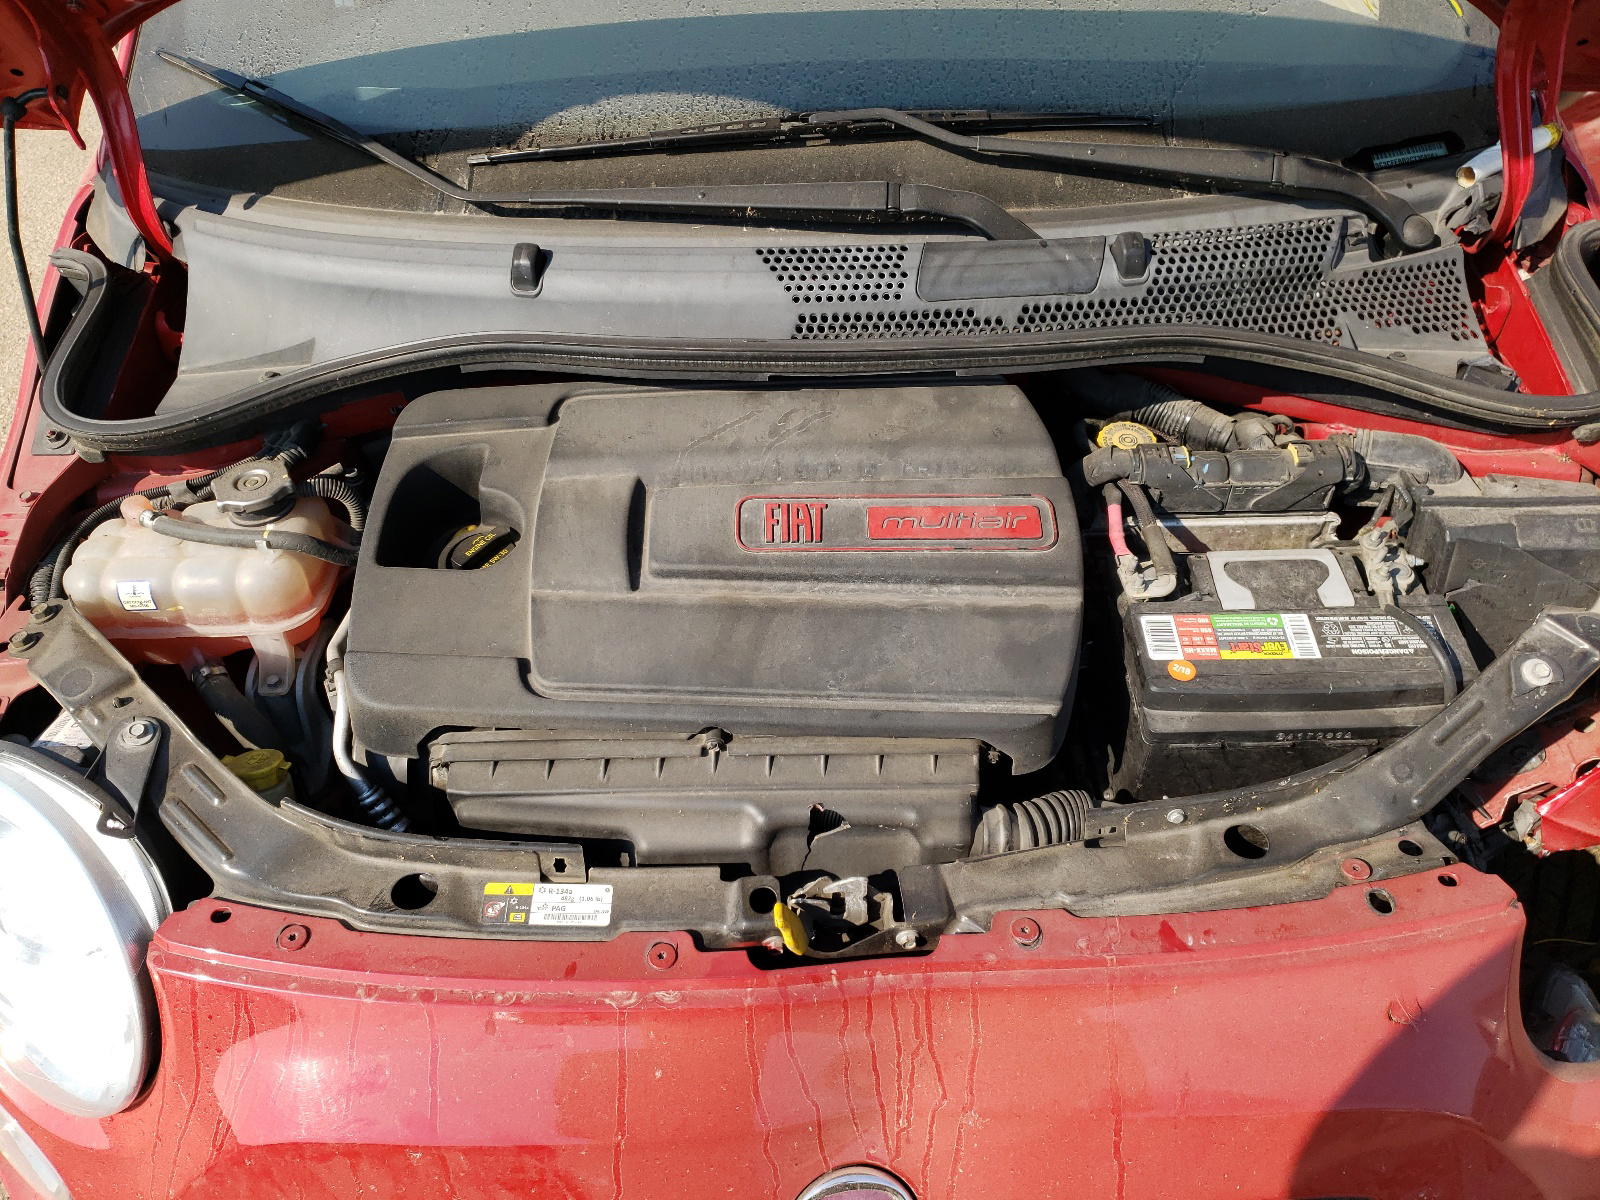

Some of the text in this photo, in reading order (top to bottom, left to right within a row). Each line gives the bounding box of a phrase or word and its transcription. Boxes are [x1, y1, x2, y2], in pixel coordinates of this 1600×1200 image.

[764, 503, 827, 543] FIAT
[881, 511, 1027, 529] multiair
[465, 533, 497, 557] ENGINE OIL
[548, 887, 573, 895] R-134a
